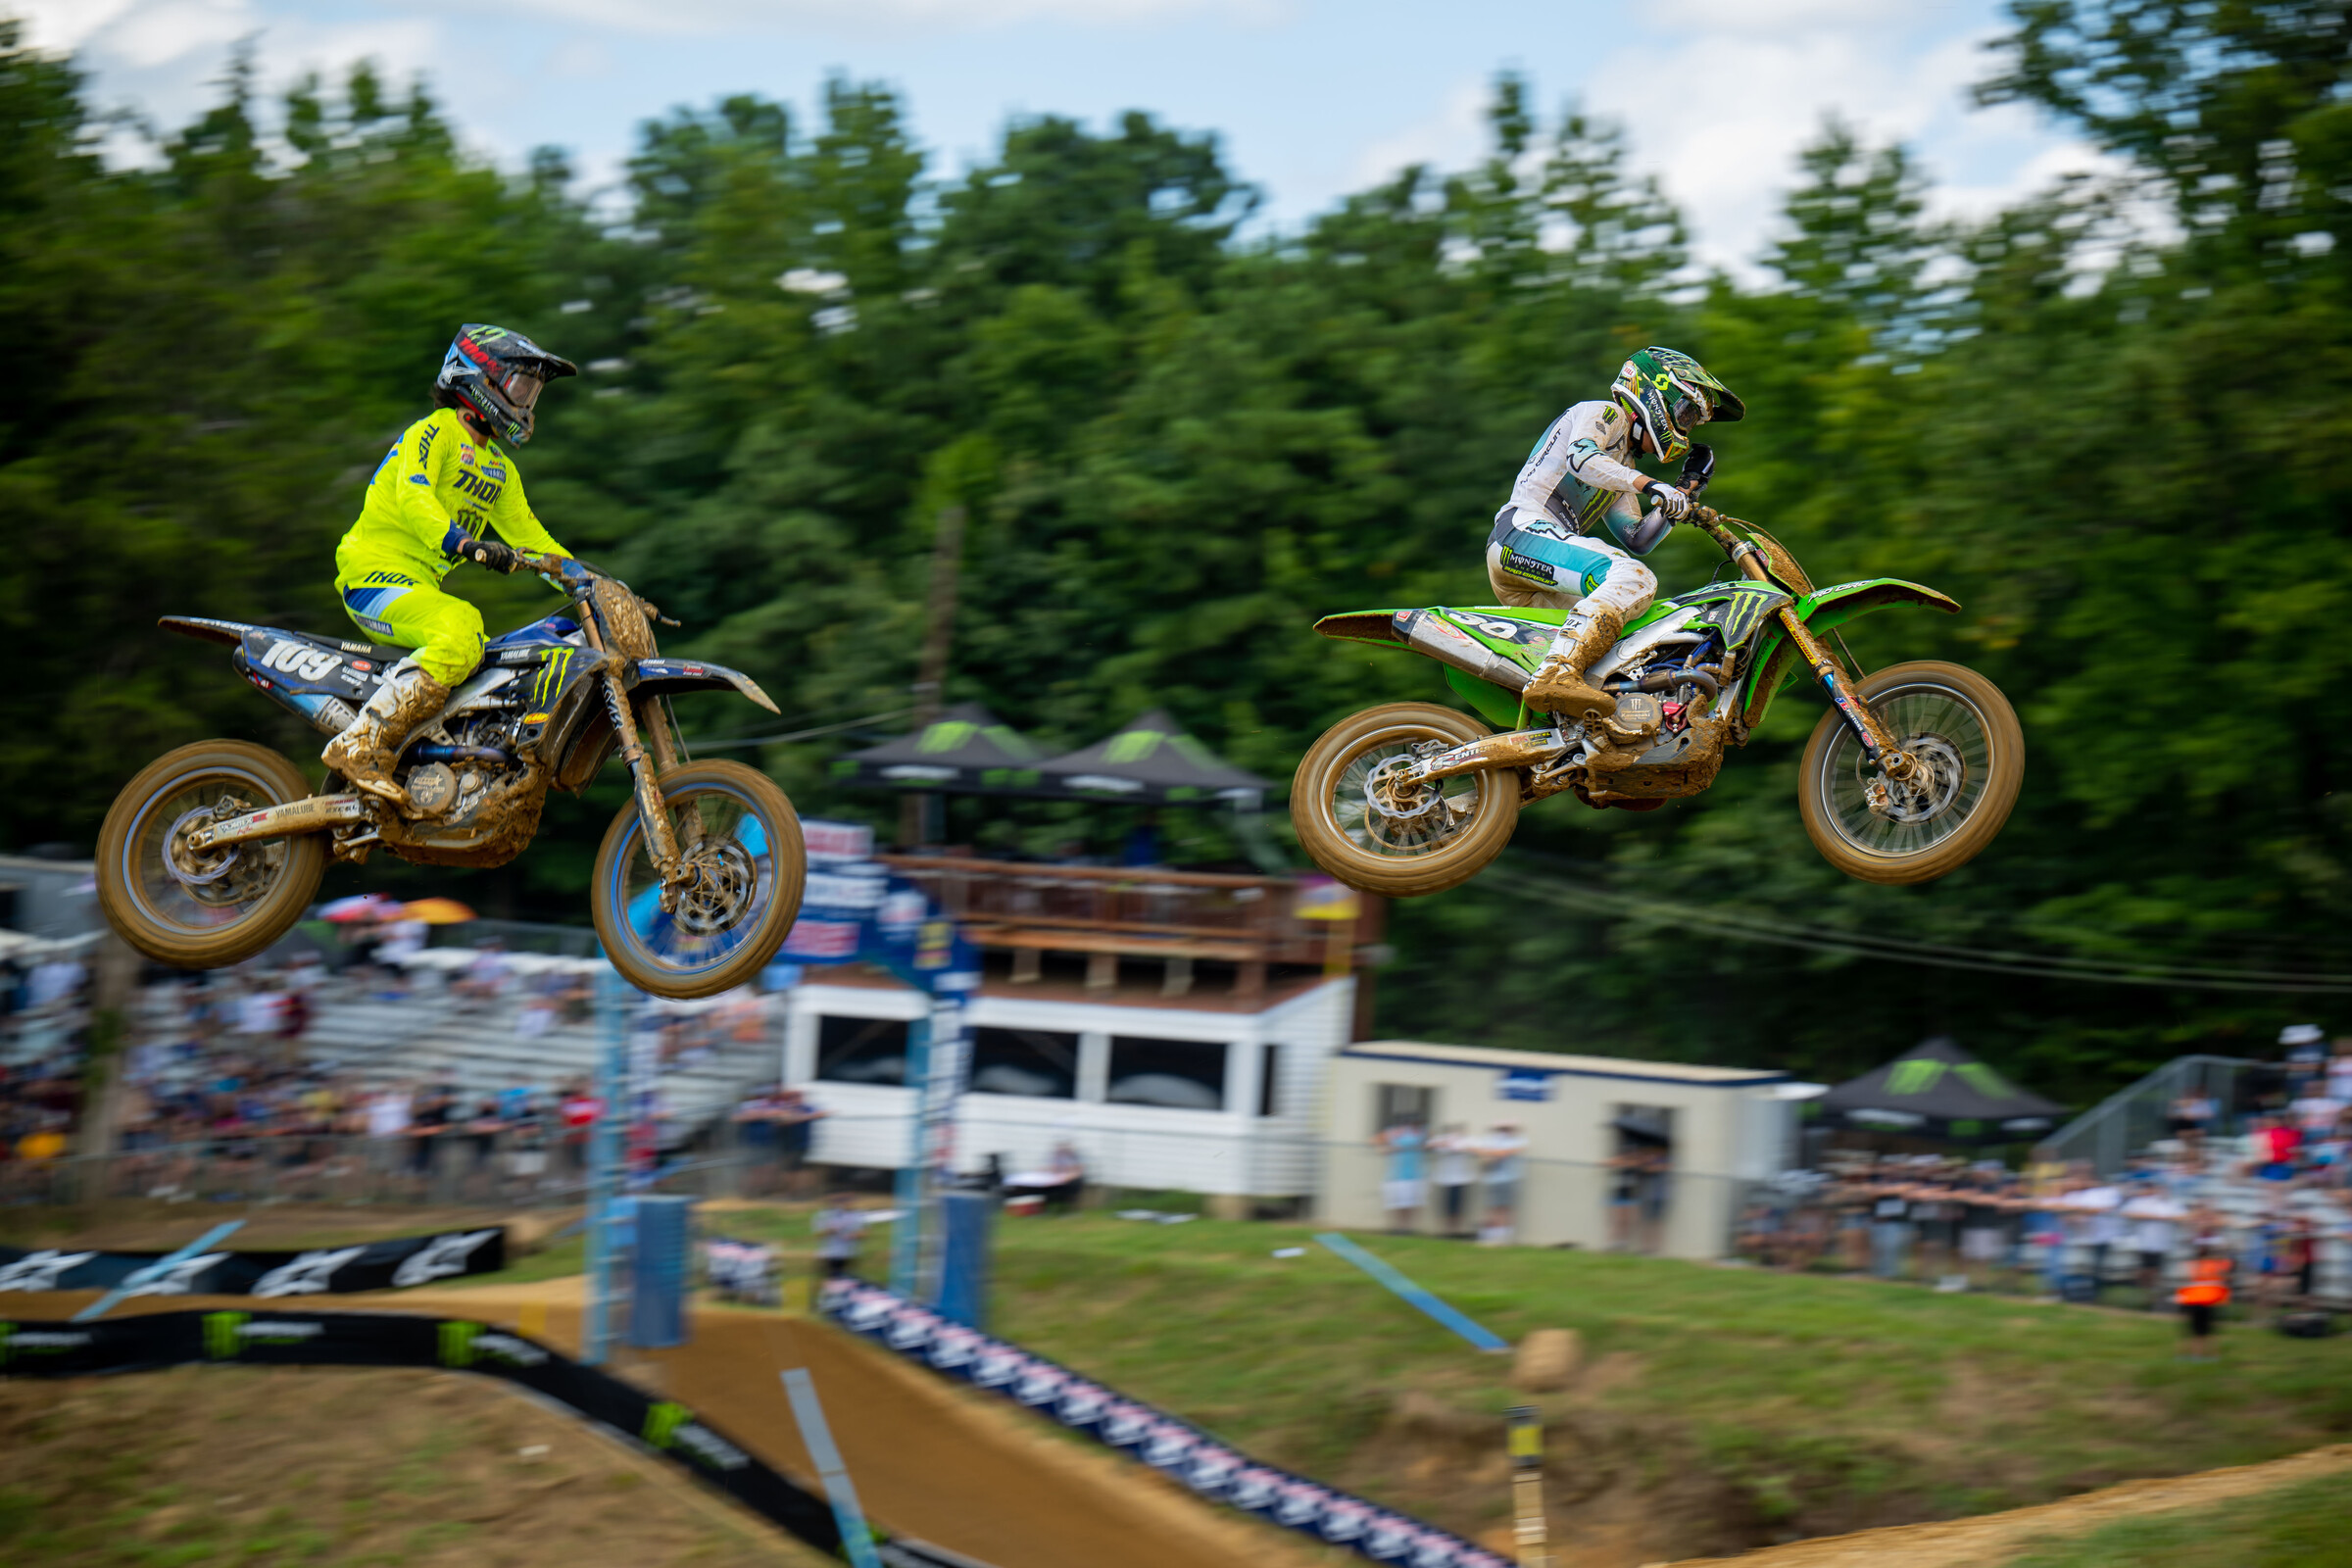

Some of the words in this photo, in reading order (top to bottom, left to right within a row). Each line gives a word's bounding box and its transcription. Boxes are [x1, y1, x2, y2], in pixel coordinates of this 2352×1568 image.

[418, 423, 440, 470] THOR
[1535, 428, 1562, 467] CIRCUIT
[261, 638, 343, 681] 109
[341, 641, 371, 654] YAMAHA
[1791, 630, 1815, 661] SHOWA
[275, 803, 316, 818] YAMALUBE
